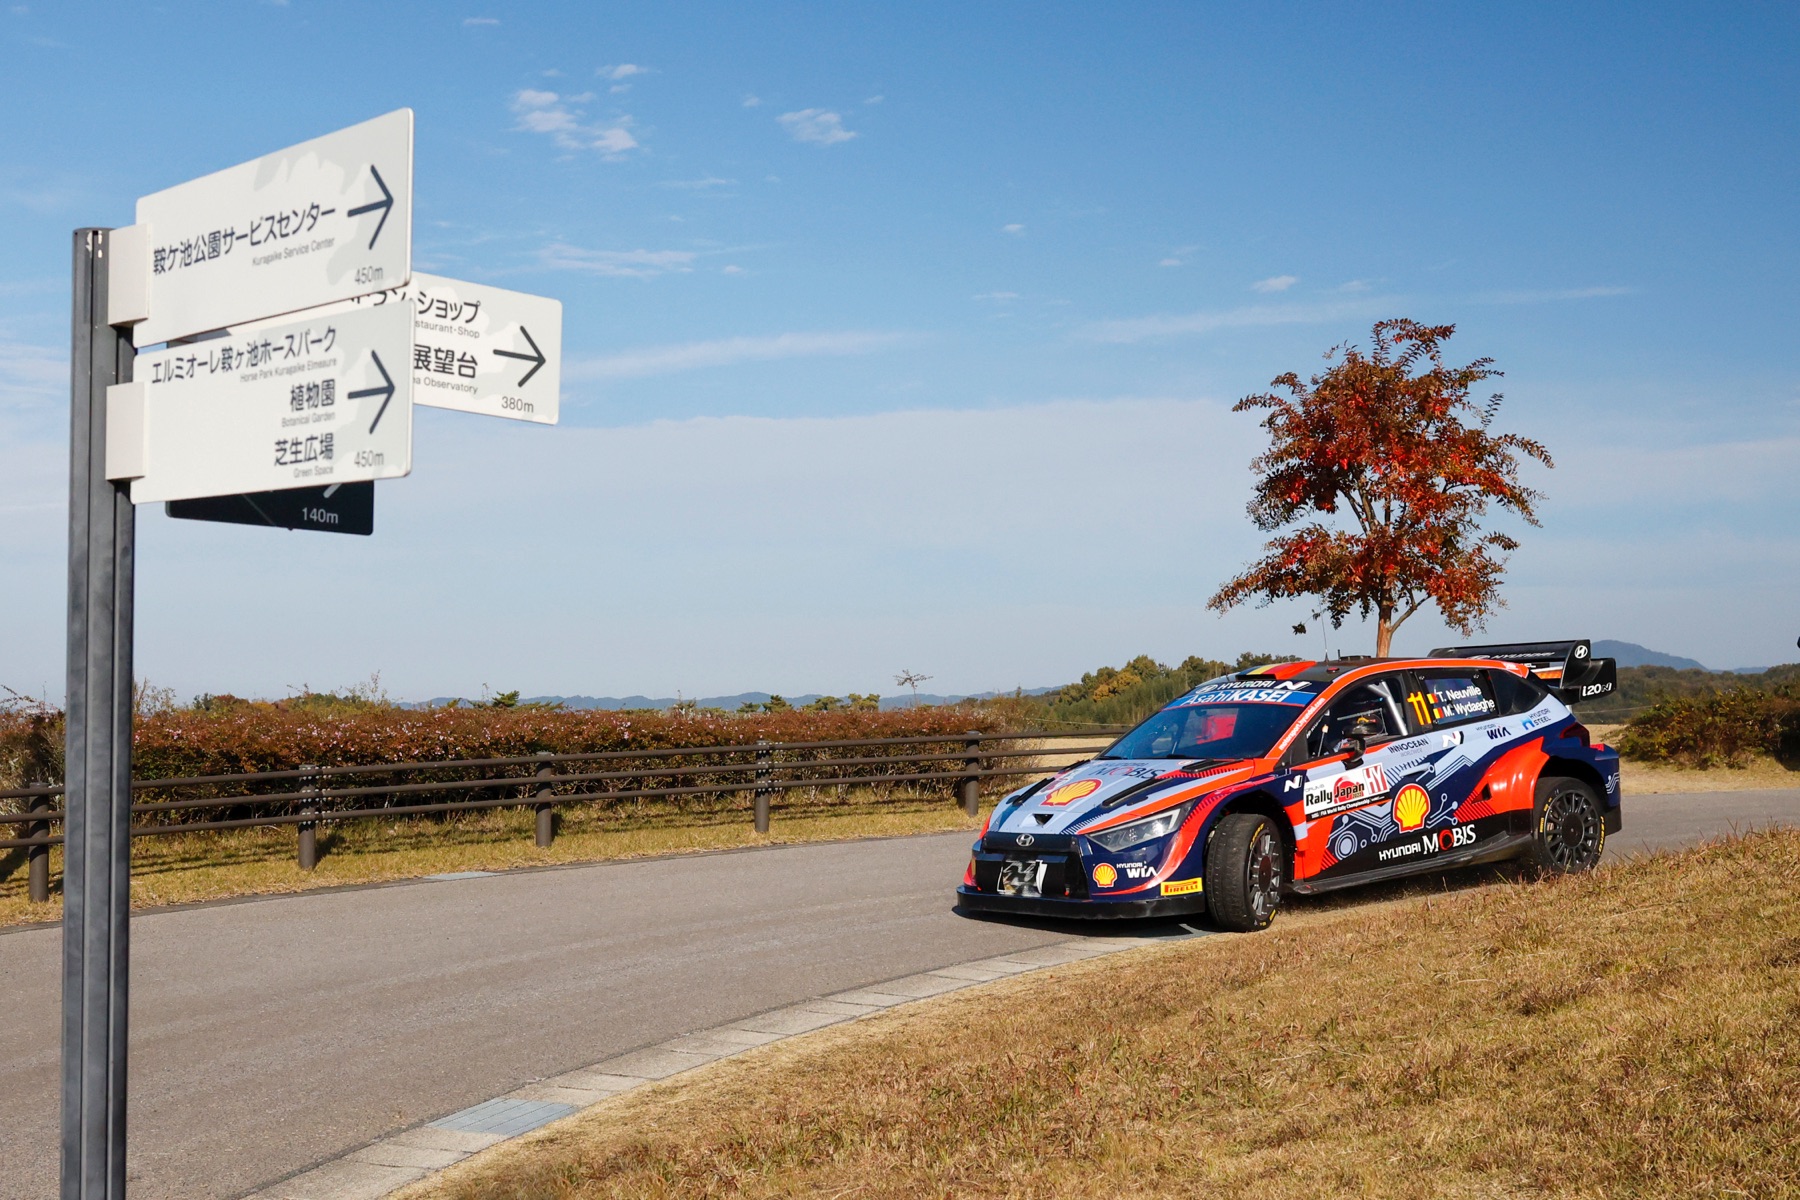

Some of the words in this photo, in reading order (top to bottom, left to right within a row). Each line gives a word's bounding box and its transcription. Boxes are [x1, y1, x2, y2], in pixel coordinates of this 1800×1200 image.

[283, 243, 309, 259] Service
[311, 237, 335, 252] Center
[354, 266, 384, 285] 450m
[413, 344, 478, 378] 展望台
[240, 373, 258, 383] Horse
[259, 369, 273, 380] Park
[423, 376, 478, 395] Observatory
[290, 379, 335, 412] 植物園
[501, 396, 534, 413] 380m
[282, 414, 310, 428] Botanical
[311, 412, 335, 423] Garden
[274, 432, 334, 467] 芝生広場
[354, 450, 384, 468] 450m
[294, 467, 313, 478] Green
[314, 466, 334, 477] Space
[301, 507, 338, 525] 140m
[1218, 680, 1276, 690] HYUNDAI
[1437, 691, 1447, 702] T.
[1446, 685, 1482, 701] Neuville
[1406, 691, 1431, 726] 11
[1443, 706, 1455, 717] M.
[1454, 698, 1496, 716] Wydaeghe
[1533, 714, 1552, 726] STEEL
[1487, 726, 1511, 740] WIA
[1387, 737, 1429, 755] INNOCEAN
[1306, 789, 1333, 807] Rally
[1334, 783, 1365, 798] Japan
[1379, 842, 1421, 861] HYUNDAI
[1422, 824, 1477, 854] MOBIS
[1164, 881, 1198, 893] PIRELLI
